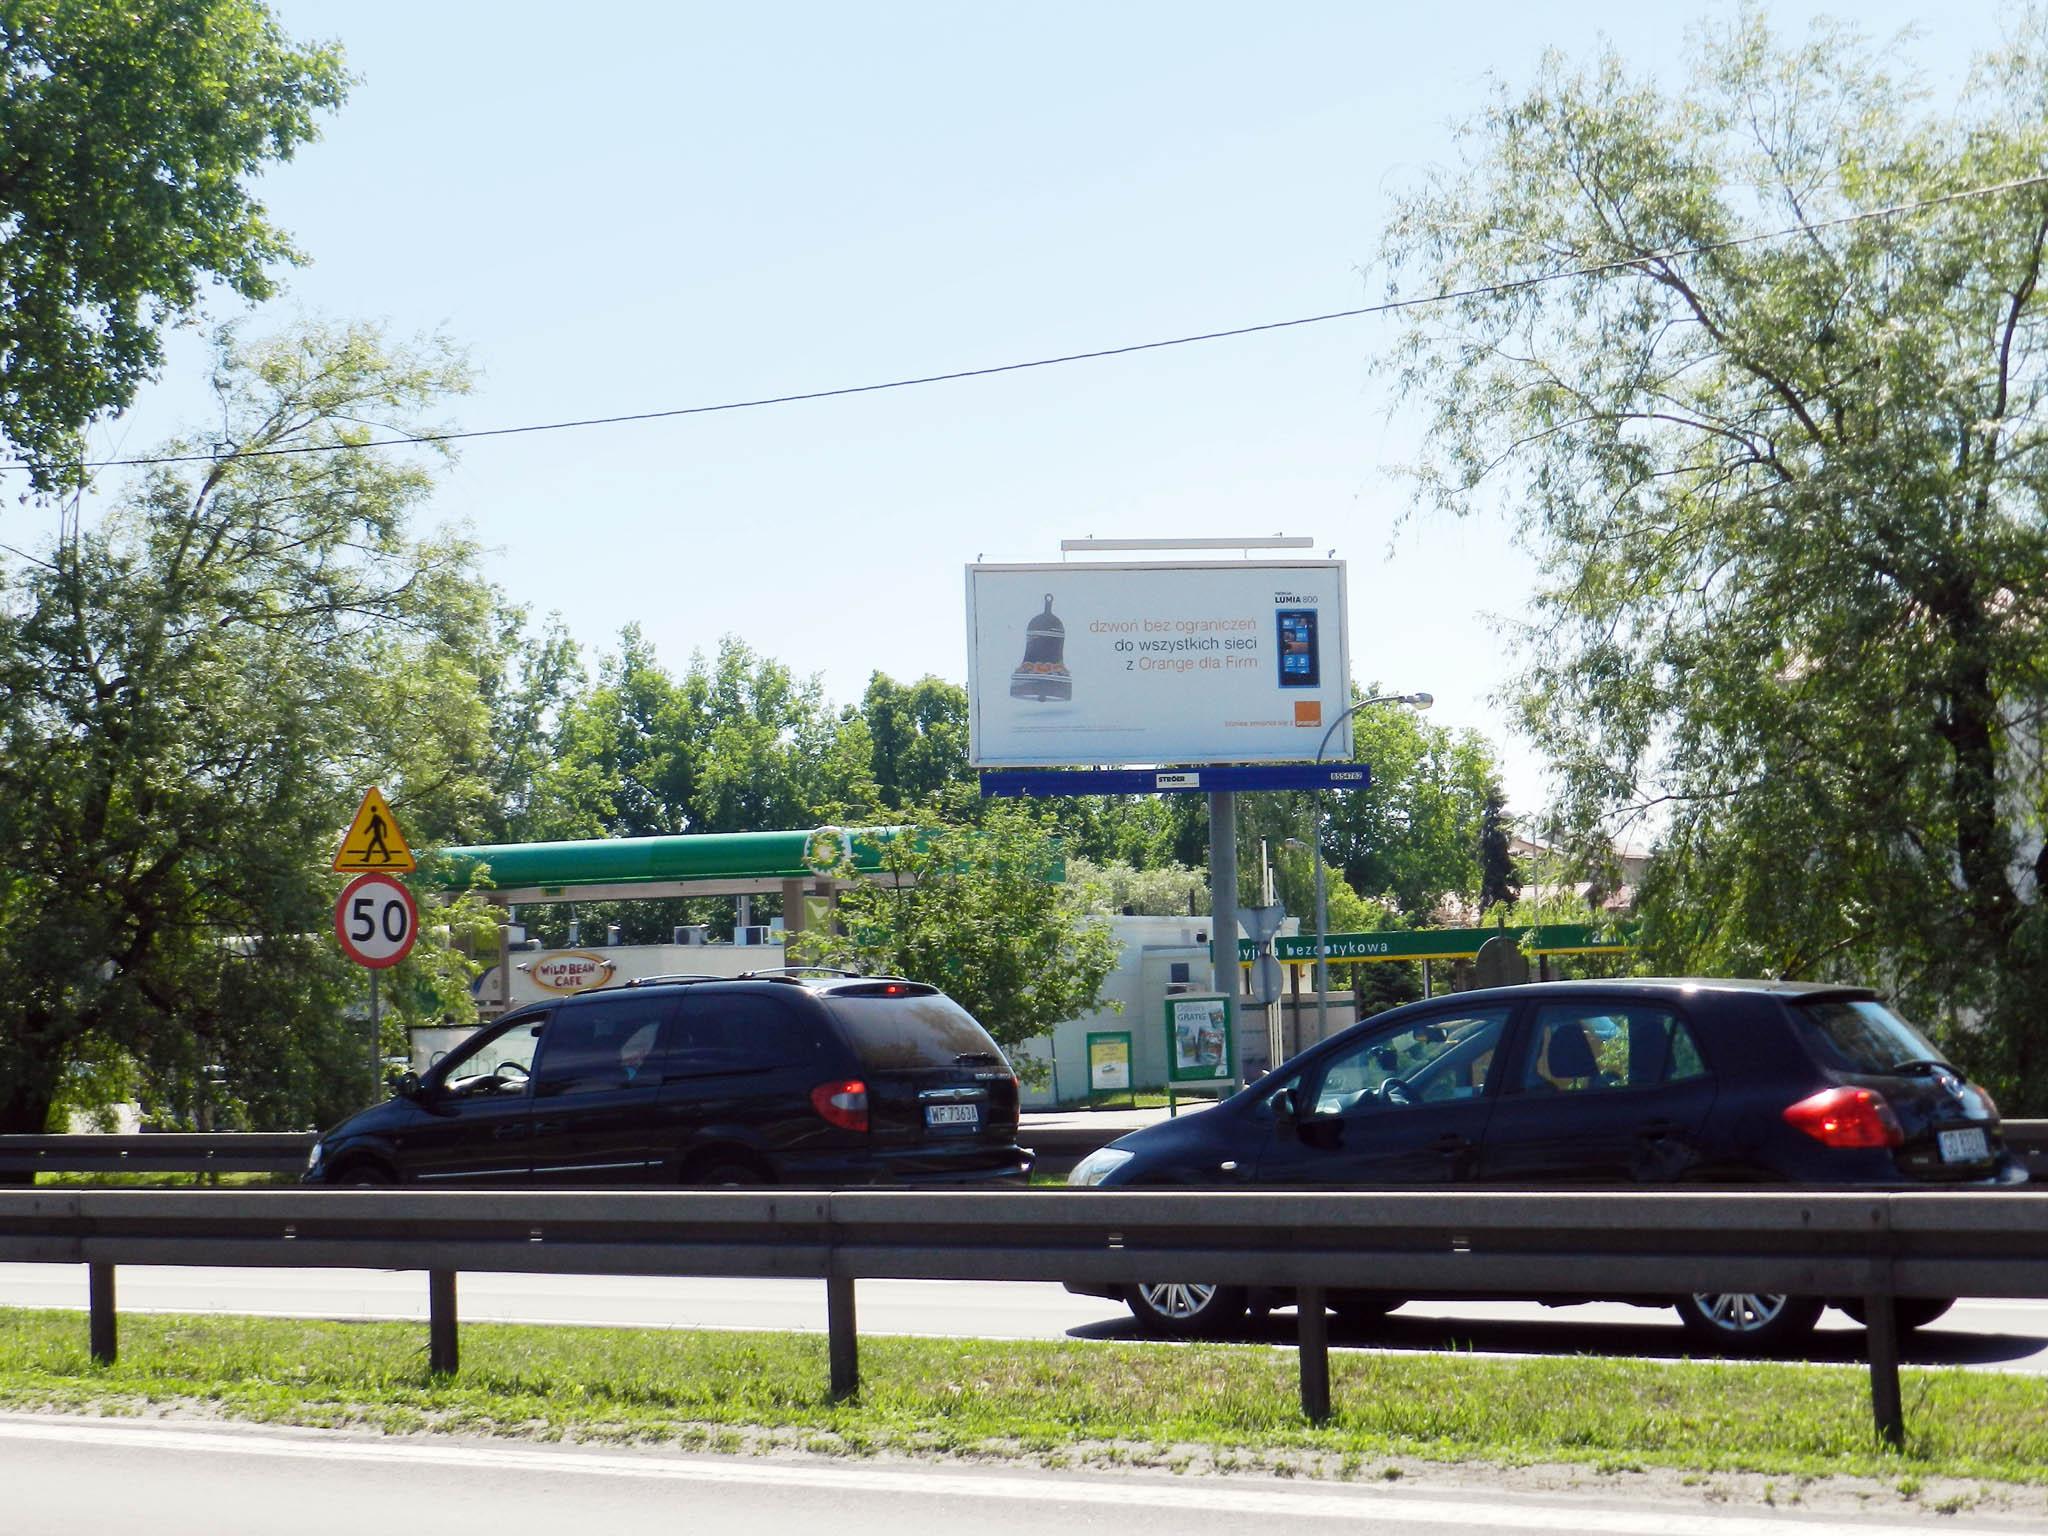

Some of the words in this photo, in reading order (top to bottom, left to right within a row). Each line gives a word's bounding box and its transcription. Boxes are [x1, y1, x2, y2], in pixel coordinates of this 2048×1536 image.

[1274, 596, 1301, 604] LUMIA
[1303, 596, 1318, 604] 800
[1089, 618, 1138, 633] dzwoń
[1144, 618, 1170, 632] bez
[1175, 616, 1257, 635] ograniczeń
[1114, 638, 1134, 652] do
[1139, 637, 1219, 654] wszystkich
[1224, 636, 1257, 650] sieci
[1126, 660, 1134, 671] z
[1138, 656, 1194, 673] Orange
[1199, 656, 1221, 670] dla
[1226, 655, 1258, 669] Firm
[351, 898, 408, 943] 50
[568, 962, 596, 975] BEAN
[554, 975, 583, 987] CAFE
[931, 1105, 945, 1121] WF
